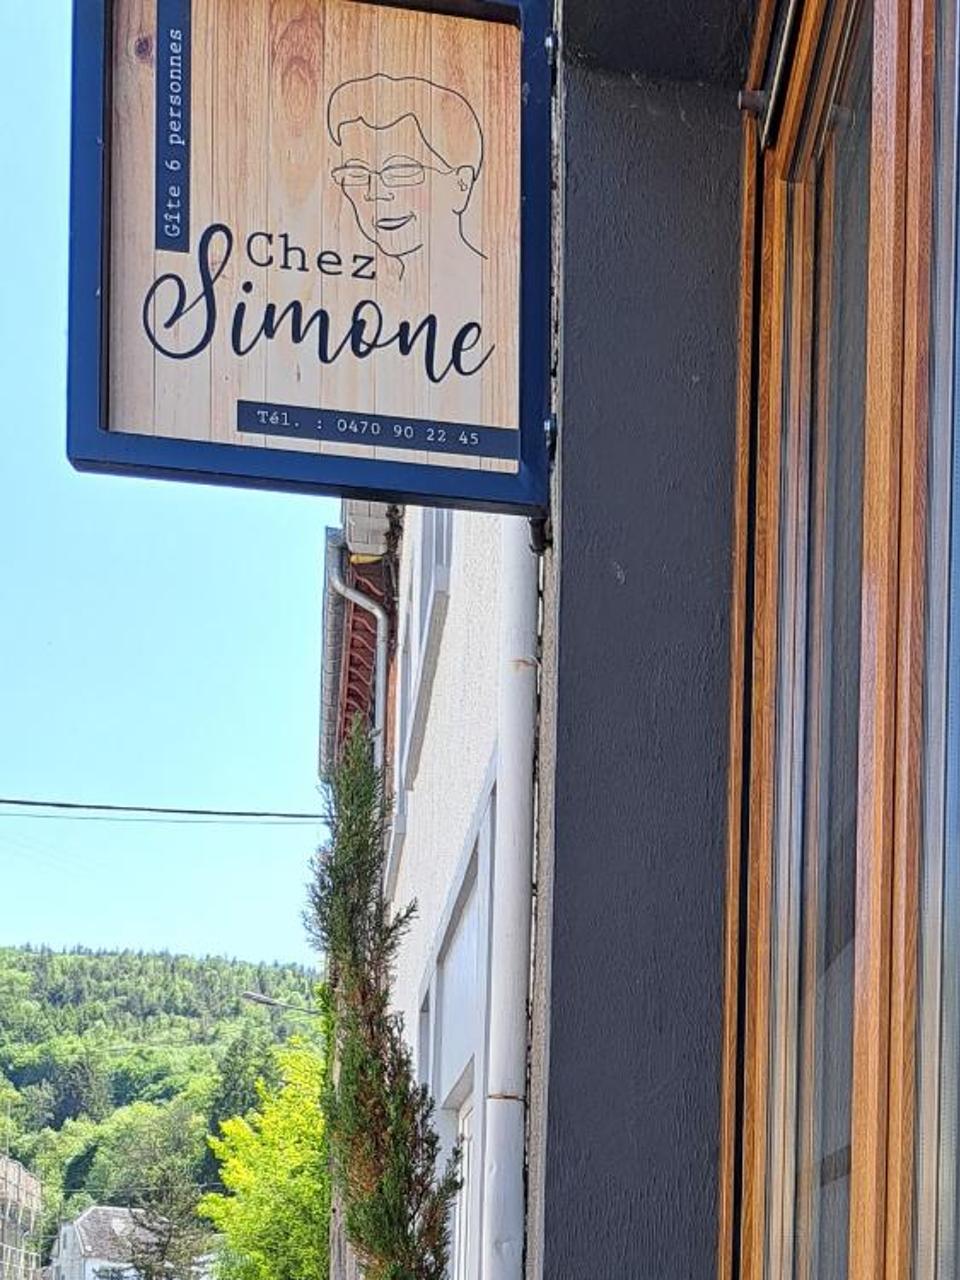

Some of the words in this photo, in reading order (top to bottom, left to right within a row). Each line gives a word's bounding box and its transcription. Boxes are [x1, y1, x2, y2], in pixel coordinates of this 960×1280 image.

[169, 28, 185, 146] personnes
[165, 159, 181, 171] 6
[164, 186, 181, 238] Gîte
[246, 232, 377, 280] Chez
[143, 223, 495, 383] Simone
[257, 410, 300, 428] Tél.
[337, 418, 381, 435] 0470
[393, 423, 414, 439] 90
[426, 427, 447, 443] 22
[458, 430, 480, 445] 45
